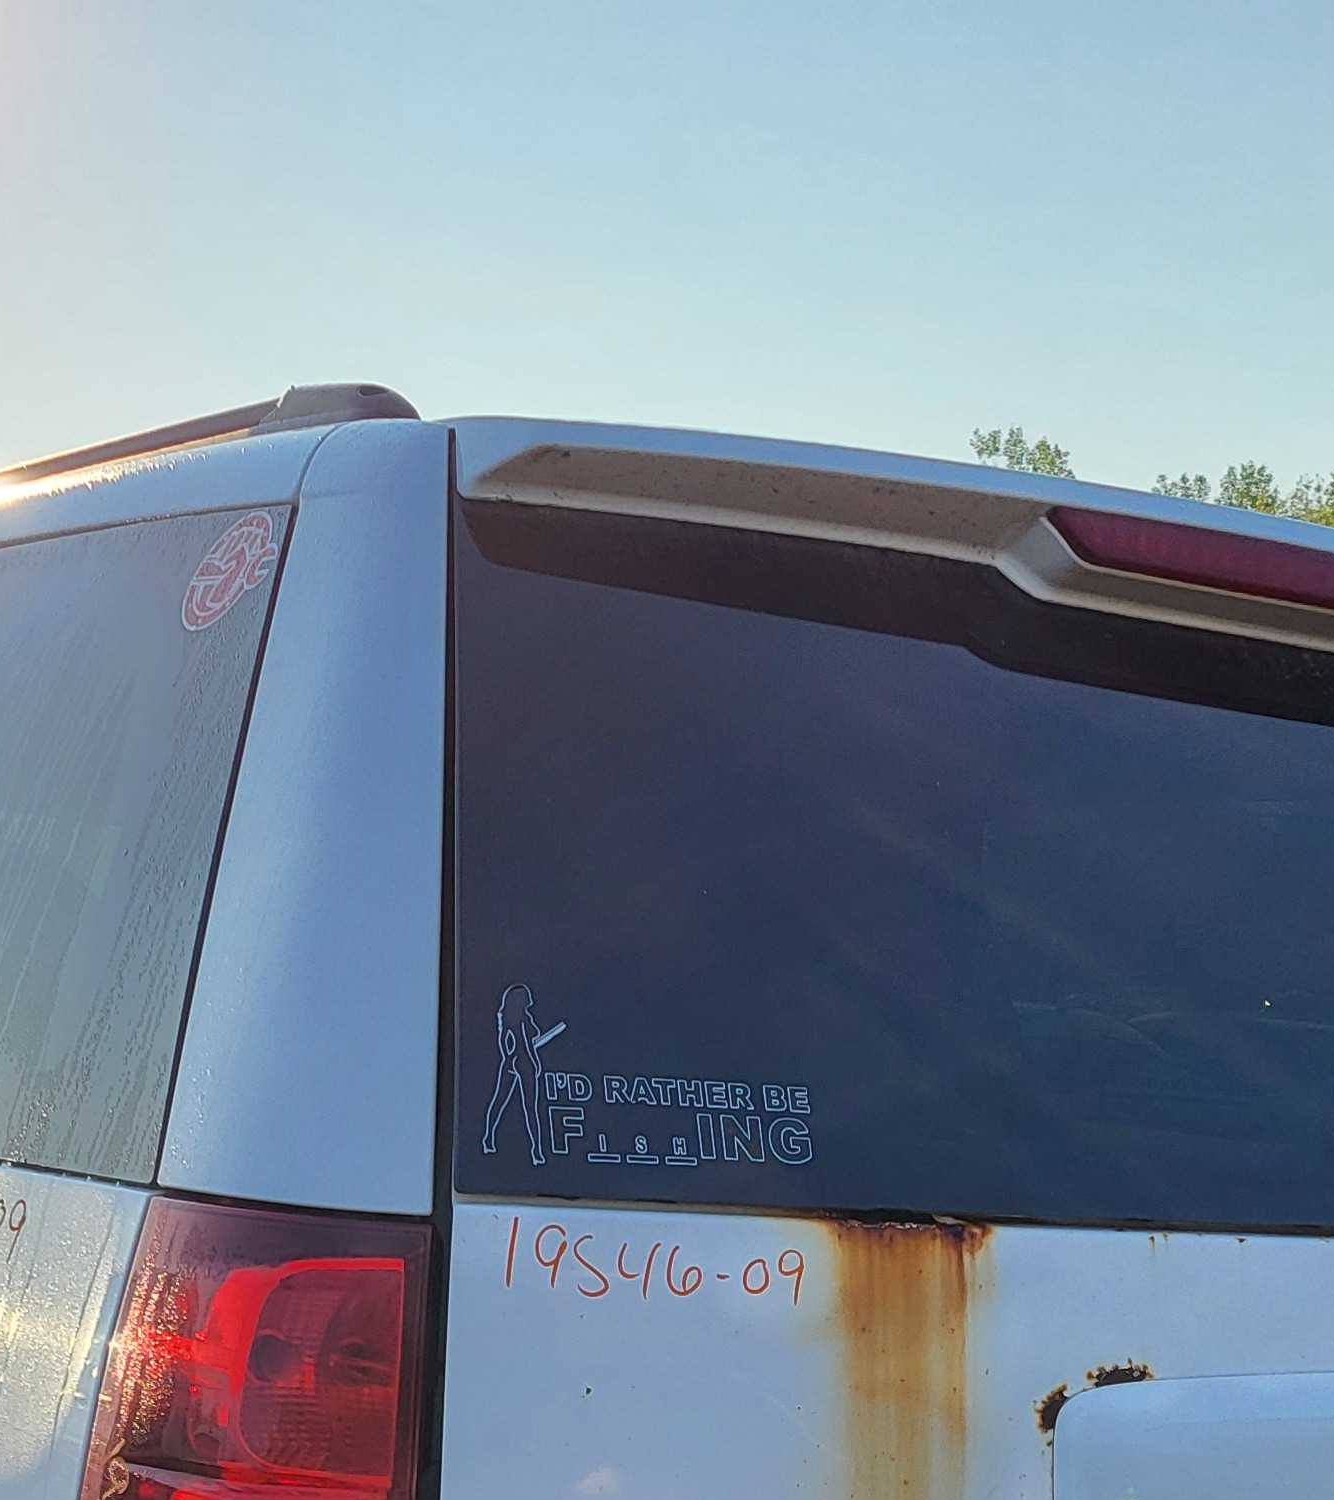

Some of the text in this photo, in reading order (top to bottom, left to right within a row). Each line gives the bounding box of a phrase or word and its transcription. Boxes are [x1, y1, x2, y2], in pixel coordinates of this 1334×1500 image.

[545, 1072, 812, 1114] I'D RATHER BE
